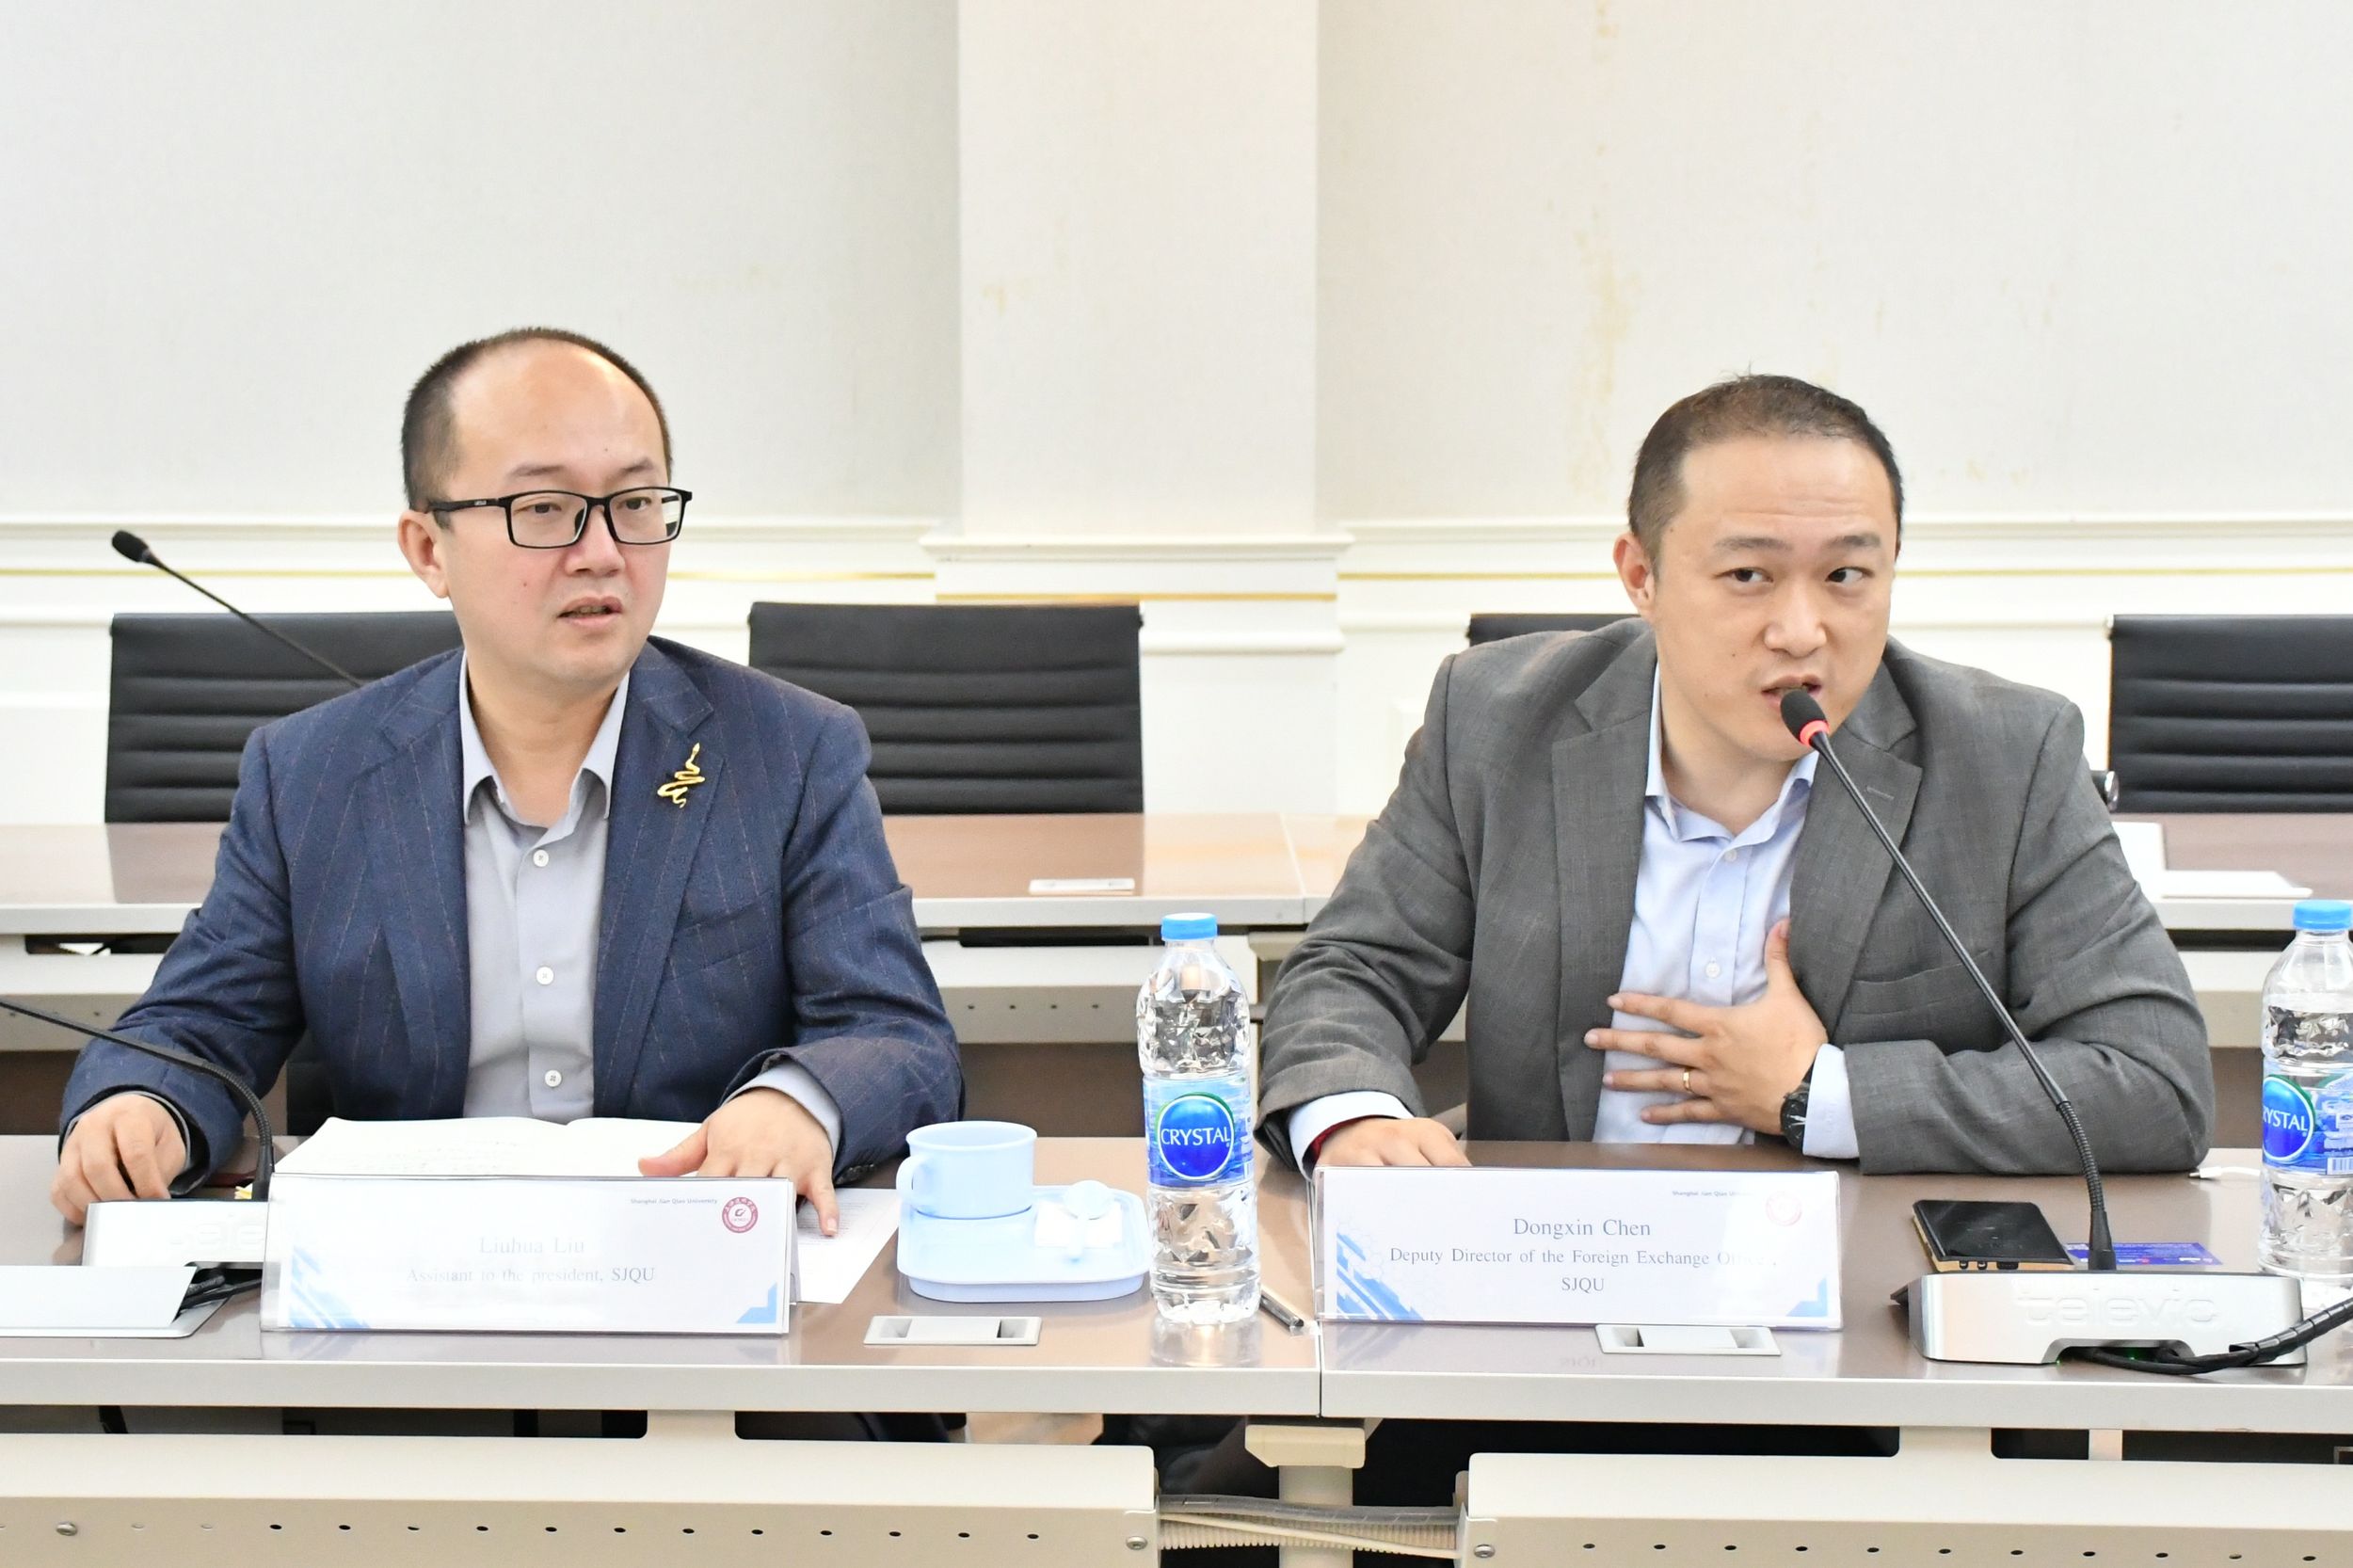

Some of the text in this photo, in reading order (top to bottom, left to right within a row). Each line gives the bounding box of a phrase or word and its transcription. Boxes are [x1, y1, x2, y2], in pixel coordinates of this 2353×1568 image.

[2263, 1105, 2309, 1131] RYSTAL
[1160, 1127, 1230, 1145] CRYSTAL
[1513, 1218, 1652, 1240] Dongxin Chen
[479, 1236, 585, 1254] Liuhua Liu
[1389, 1247, 1443, 1266] Deputy
[1451, 1248, 1513, 1263] Director
[1519, 1248, 1535, 1264] of
[1542, 1248, 1564, 1264] the
[1572, 1249, 1629, 1267] Foreign
[1637, 1250, 1710, 1267] Exchange
[407, 1267, 655, 1284] Assistant to the president, SJQU
[1561, 1277, 1606, 1293] SJQU
[2013, 1287, 2218, 1330] televic
